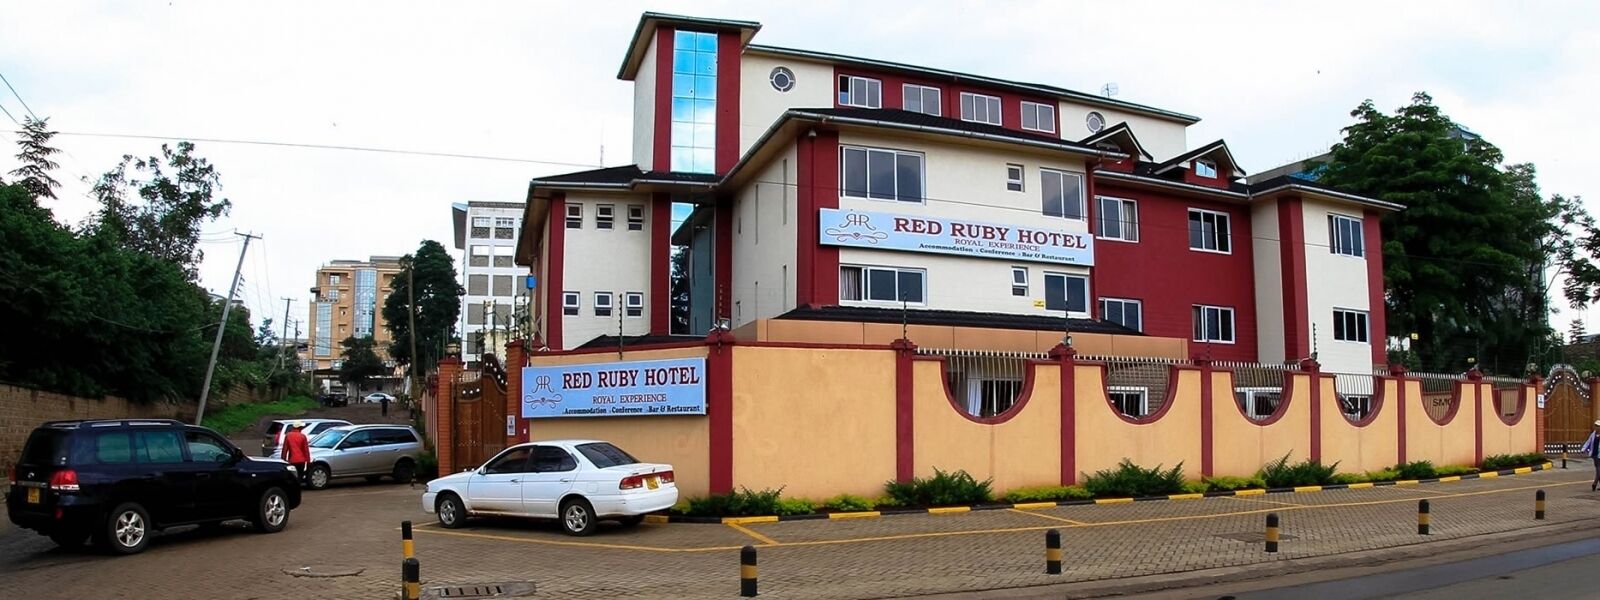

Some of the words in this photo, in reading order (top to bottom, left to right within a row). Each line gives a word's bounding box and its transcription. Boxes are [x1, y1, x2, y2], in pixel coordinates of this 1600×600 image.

[893, 217, 943, 235] RED
[950, 222, 1010, 241] RUBY
[1017, 229, 1087, 249] HOTEL
[919, 243, 974, 252] Accommodation
[980, 248, 1015, 256] Conference
[1041, 253, 1075, 262] Restaurant
[954, 238, 984, 247] ROYAL
[988, 241, 1040, 252] EXPERIENCE
[562, 372, 592, 390] RED
[597, 369, 639, 388] RUBY
[644, 366, 700, 386] HOTEL
[592, 396, 616, 404] ROYAL
[620, 393, 667, 404] EXPERIENCE
[564, 407, 607, 415] Accommodation
[611, 406, 643, 414] Conference
[648, 405, 659, 413] Bar
[660, 405, 666, 413] &
